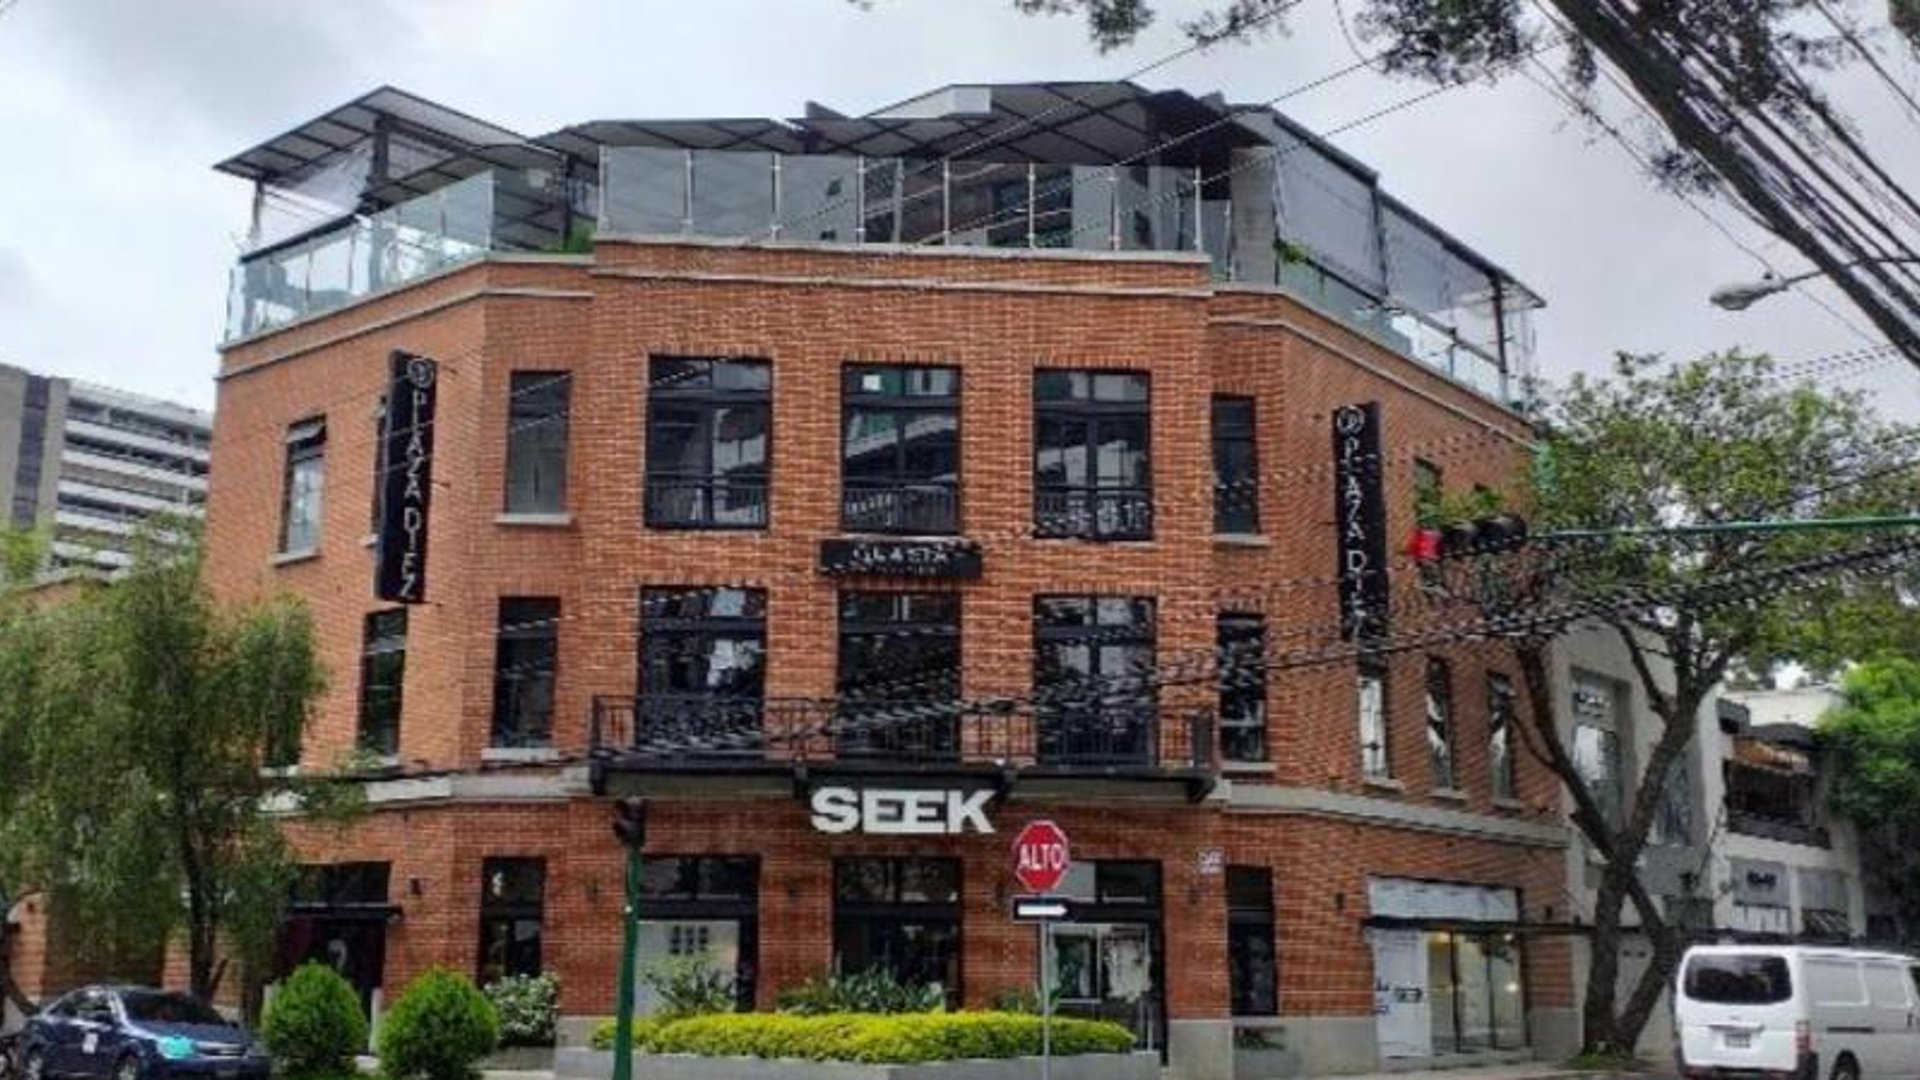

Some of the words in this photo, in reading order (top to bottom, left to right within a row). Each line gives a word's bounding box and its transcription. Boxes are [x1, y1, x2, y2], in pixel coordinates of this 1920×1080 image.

[404, 390, 428, 499] PLAZA
[400, 507, 422, 598] DIEZ
[811, 786, 996, 833] SEEK
[1018, 843, 1063, 871] ALTO
